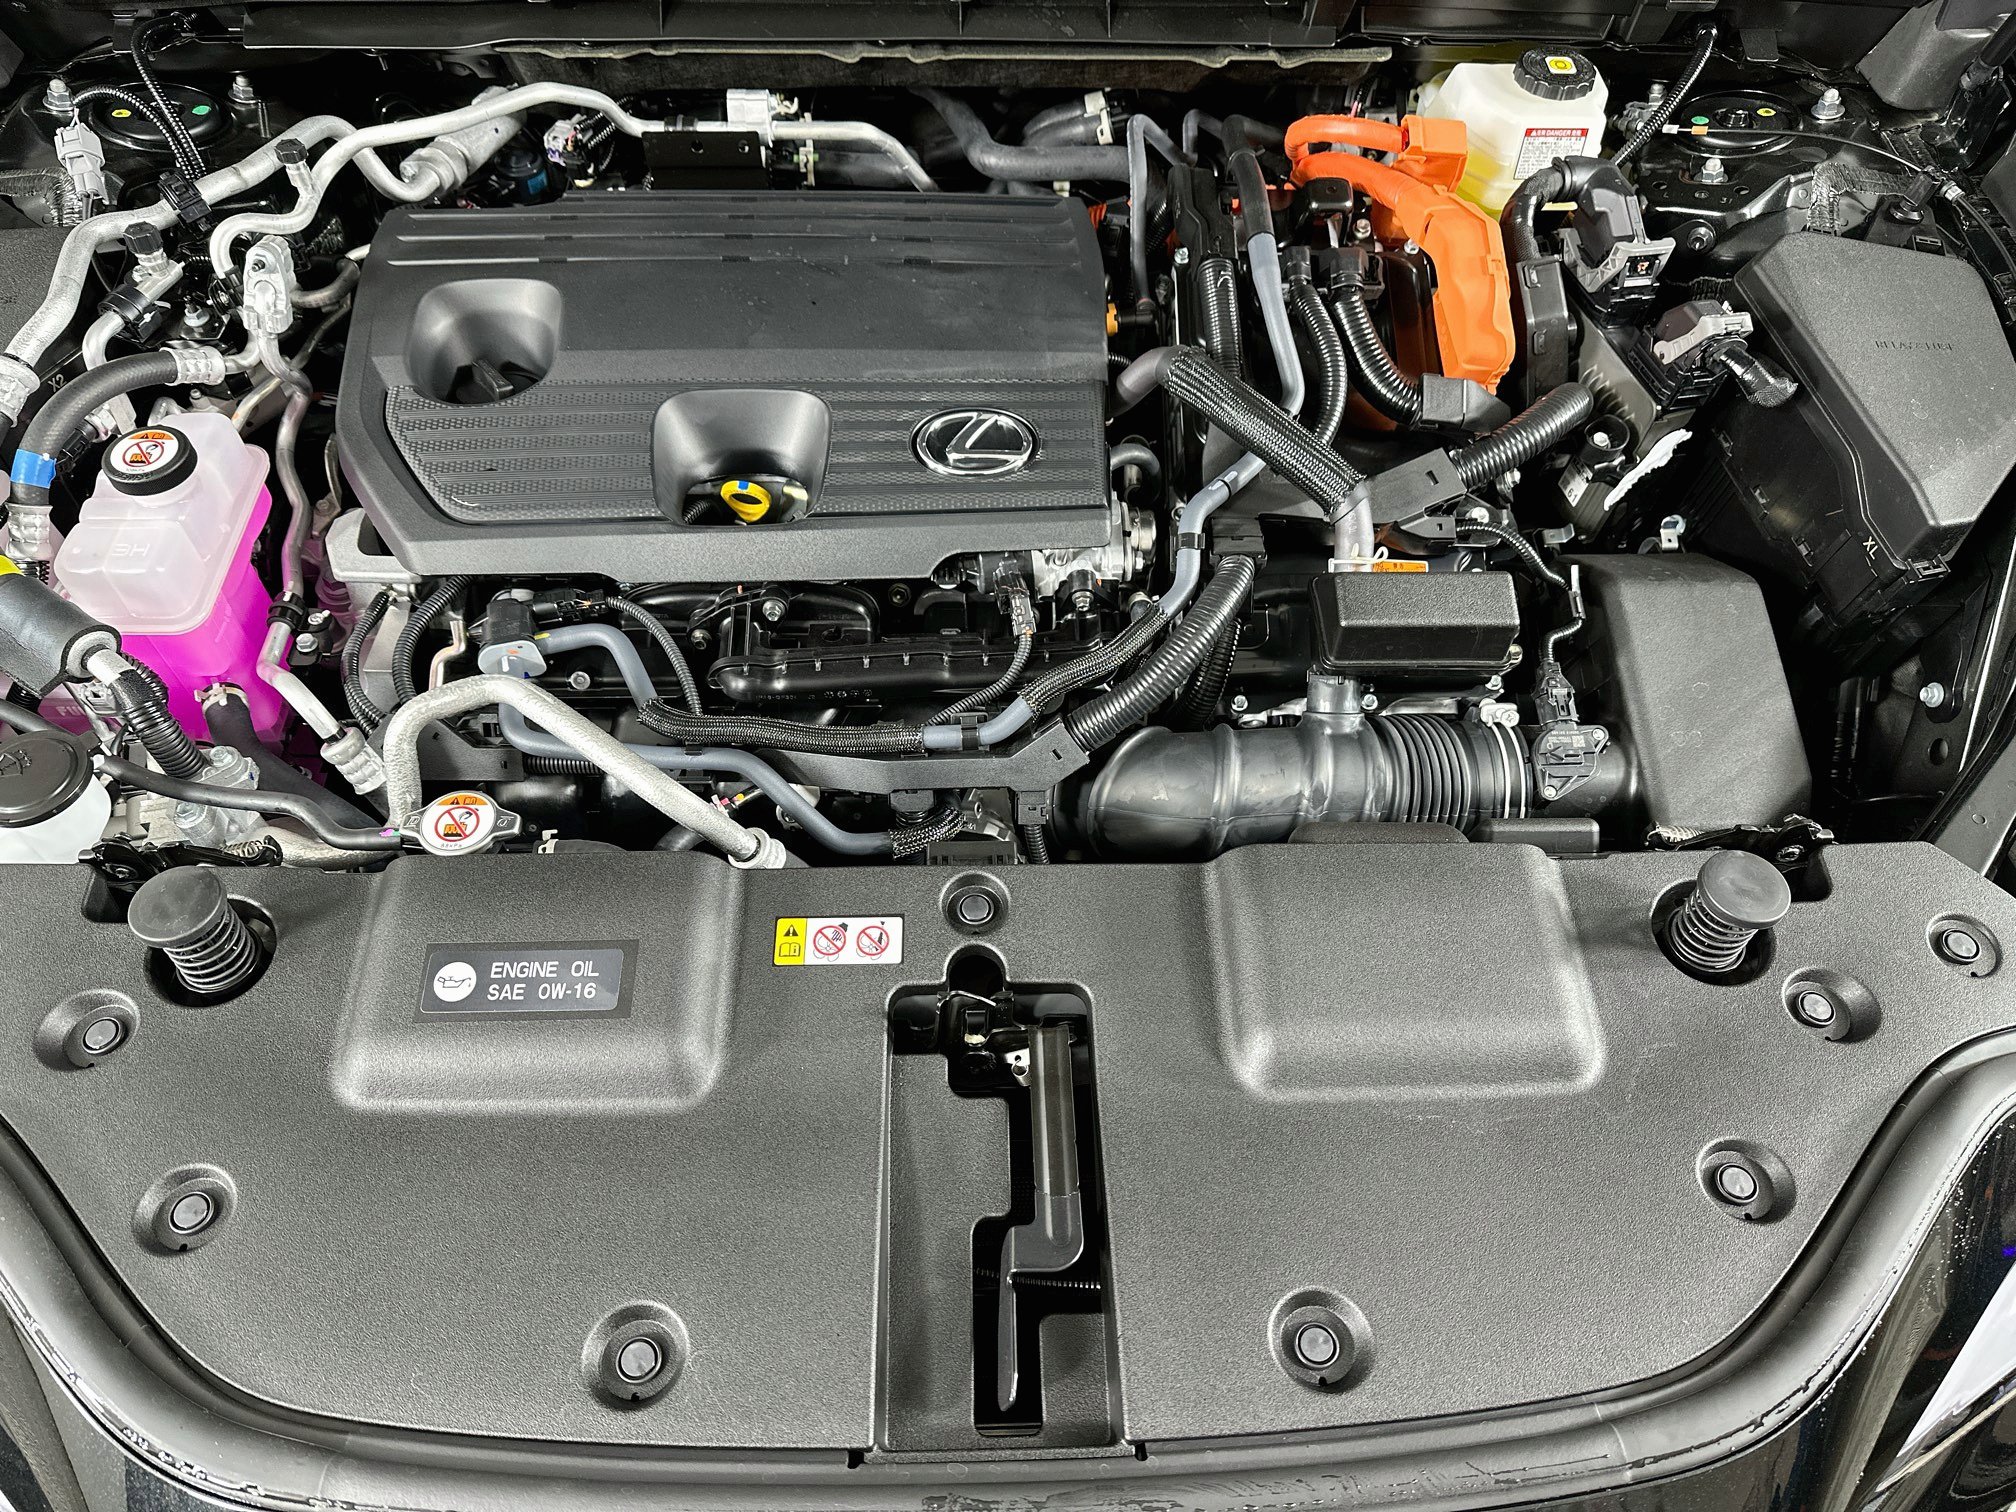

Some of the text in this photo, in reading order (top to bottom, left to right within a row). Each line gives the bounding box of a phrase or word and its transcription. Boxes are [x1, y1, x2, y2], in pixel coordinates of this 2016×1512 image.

[47, 373, 67, 393] X2
[490, 960, 600, 979] ENGINE OIL
[487, 982, 597, 1001] SAE 0W-16
